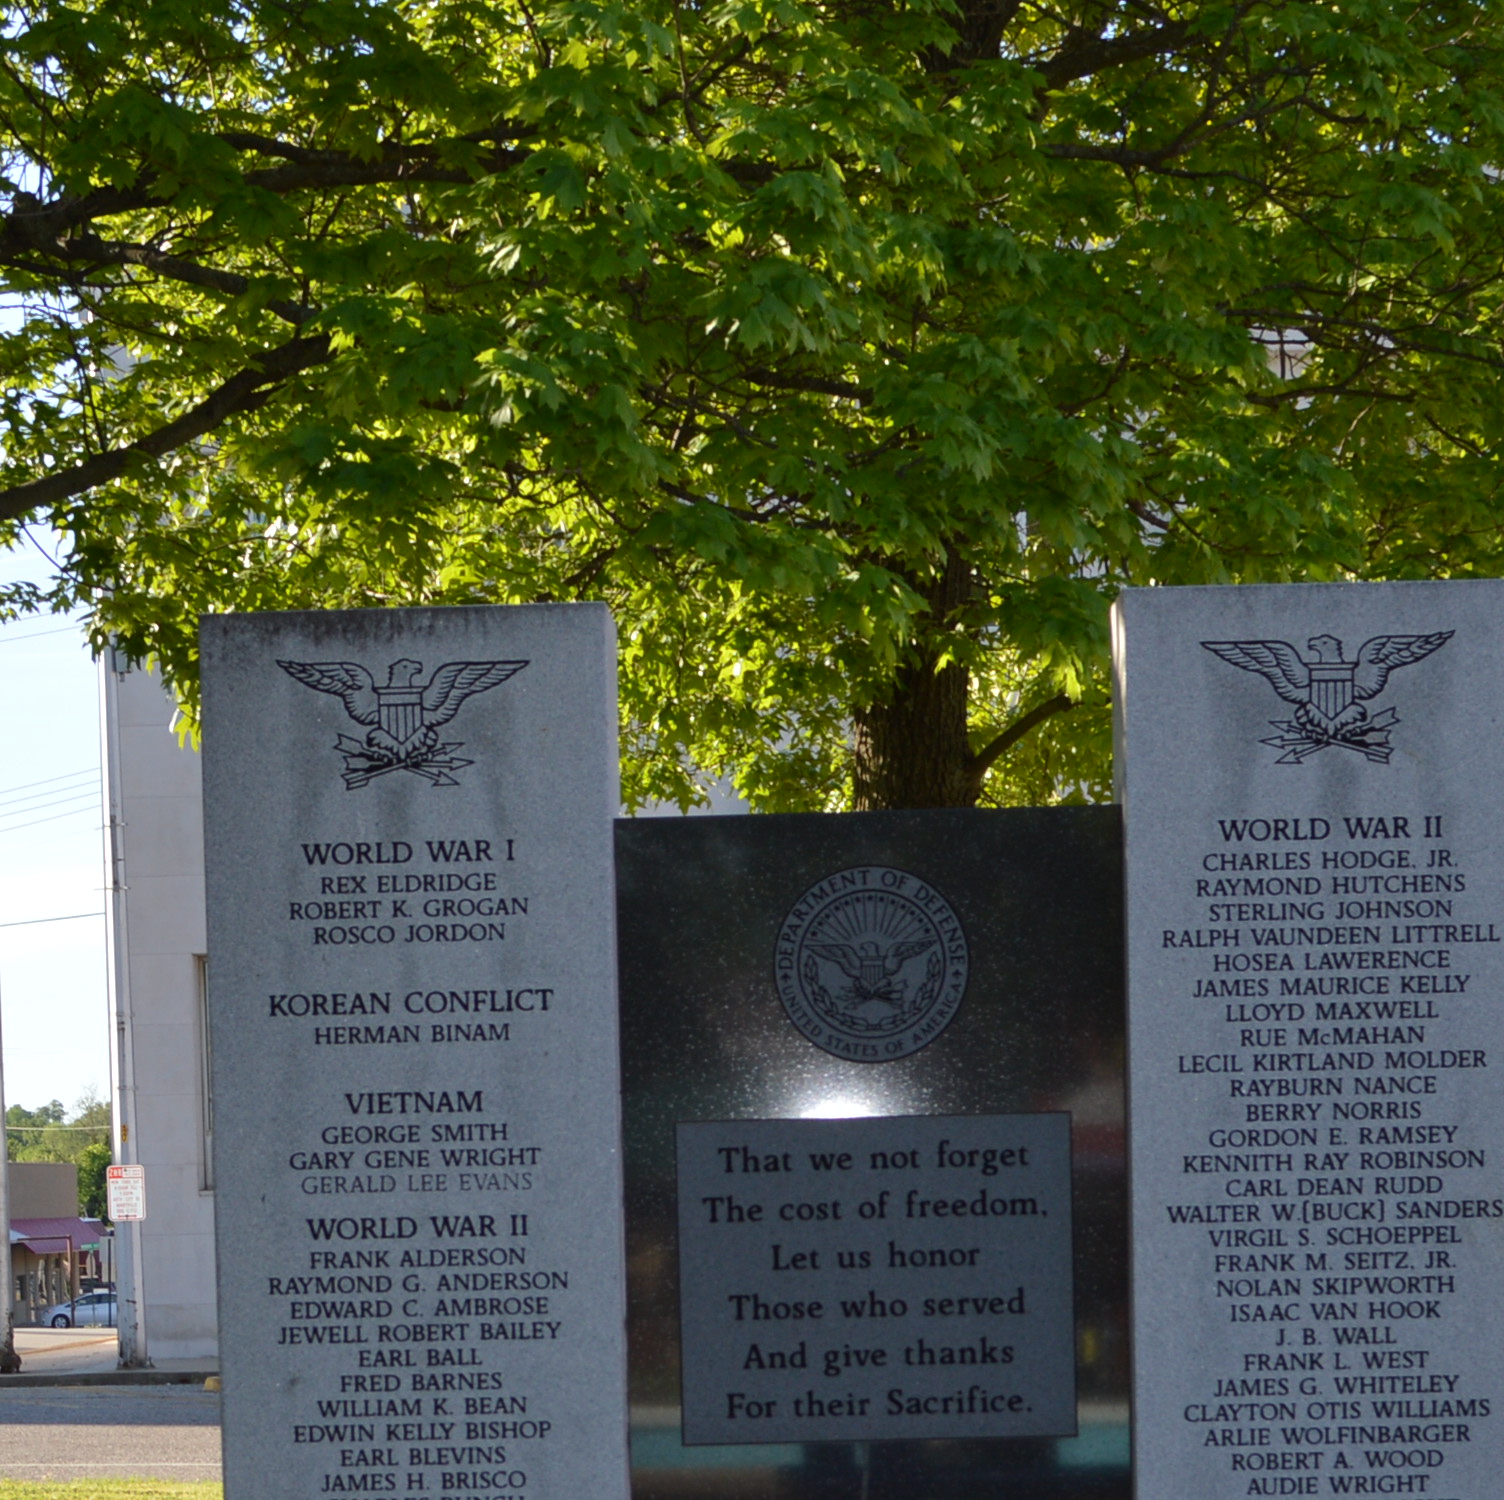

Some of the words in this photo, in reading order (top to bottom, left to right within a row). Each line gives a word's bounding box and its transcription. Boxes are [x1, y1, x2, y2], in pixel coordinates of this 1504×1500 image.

[1218, 818, 1330, 841] WORLD
[1343, 817, 1410, 839] WAR
[1425, 816, 1442, 838] II
[301, 841, 413, 865] WORLD
[426, 840, 492, 862] WAR
[507, 839, 514, 861] I
[321, 876, 366, 894] REX
[378, 873, 496, 893] ELDRIDGE
[1196, 877, 1321, 897] RAYMOND
[1332, 874, 1465, 894] HUTCHENS
[779, 870, 870, 971] DEPARTMENT
[881, 870, 909, 889] OF
[914, 886, 966, 966] DEFENSE
[1209, 902, 1324, 922] STERLING
[1336, 900, 1452, 919] JOHNSON
[314, 926, 395, 945] ROSCO
[404, 923, 505, 943] JORDON
[1162, 929, 1239, 948] RALPH
[1251, 926, 1380, 946] VAUNDEEN
[1392, 924, 1500, 944] LITTRELL
[1214, 953, 1294, 972] HOSEA
[1305, 950, 1450, 970] LAWERENCE
[1193, 978, 1268, 998] JAMES
[1280, 976, 1389, 996] MAURICE
[1401, 975, 1470, 993] KELLY
[270, 992, 390, 1016] KOREAN
[404, 989, 554, 1013] CONFLICT
[1226, 1003, 1304, 1022] LLOYD
[1316, 1001, 1439, 1020] MAXWELL
[782, 985, 822, 1038] UNITED
[825, 1036, 877, 1056] STATES
[885, 1040, 905, 1054] OF
[913, 983, 962, 1042] AMERICA
[315, 1025, 419, 1045] HERMAN
[432, 1023, 509, 1042] BINAM
[1241, 1029, 1286, 1047] RUE
[1298, 1026, 1424, 1045] McMAHAN
[1230, 1078, 1342, 1097] RAYBURN
[1354, 1076, 1436, 1094] NANCE
[345, 1091, 482, 1114] VIETNAM
[1246, 1103, 1322, 1122] BERRY
[1333, 1101, 1421, 1120] NORRIS
[321, 1125, 420, 1144] GEORGE
[432, 1123, 507, 1142] SMITH
[289, 1152, 354, 1170] GARY
[365, 1150, 429, 1168] GENE
[440, 1147, 541, 1167] WRIGHT
[718, 1146, 792, 1173] That
[809, 1153, 852, 1171] we
[870, 1150, 919, 1169] not
[938, 1140, 1028, 1175] forget
[1183, 1154, 1292, 1173] KENNITH
[1304, 1153, 1349, 1171] RAY
[1360, 1150, 1484, 1170] ROBINSON
[1226, 1179, 1287, 1197] CARL
[1298, 1177, 1363, 1196] DEAN
[1375, 1176, 1443, 1194] RUDD
[702, 1195, 762, 1223] The
[779, 1201, 841, 1221] cost
[858, 1191, 889, 1219] of
[905, 1191, 1047, 1220] freedom,
[306, 1217, 417, 1240] WORLD
[430, 1215, 496, 1238] WAR
[511, 1214, 527, 1236] II
[310, 1251, 389, 1269] FRANK
[400, 1247, 525, 1267] ALDERSON
[772, 1244, 819, 1271] Let
[837, 1251, 871, 1269] us
[888, 1241, 980, 1268] honor
[1217, 1279, 1300, 1297] NOLAN
[1313, 1275, 1454, 1296] SKIPWORTH
[728, 1293, 823, 1321] Those
[840, 1290, 907, 1318] who
[923, 1288, 1025, 1316] served
[1231, 1303, 1300, 1322] ISAAC
[1310, 1303, 1357, 1320] VAN
[1369, 1301, 1440, 1319] HOOK
[278, 1325, 368, 1344] JEWELL
[379, 1323, 469, 1342] ROBERT
[480, 1321, 561, 1340] BAILEY
[359, 1350, 416, 1367] EARL
[427, 1348, 482, 1367] BALL
[743, 1342, 807, 1370] And
[824, 1344, 886, 1375] give
[904, 1338, 1013, 1366] thanks
[341, 1375, 401, 1393] FRED
[412, 1372, 502, 1391] BARNES
[727, 1393, 776, 1419] For
[794, 1390, 870, 1417] their
[887, 1386, 1032, 1415] Sacrifice.
[1184, 1403, 1296, 1422] CLAYTON
[1307, 1401, 1361, 1420] OTIS
[1372, 1399, 1490, 1418] WILLIAMS
[1204, 1428, 1270, 1447] ARLIE
[1281, 1424, 1470, 1445] WOLFINBARGER
[341, 1449, 399, 1467] EARL
[410, 1446, 506, 1466] BLEVINS
[1247, 1477, 1318, 1495] AUDIE
[1329, 1475, 1430, 1494] WRIGHT
